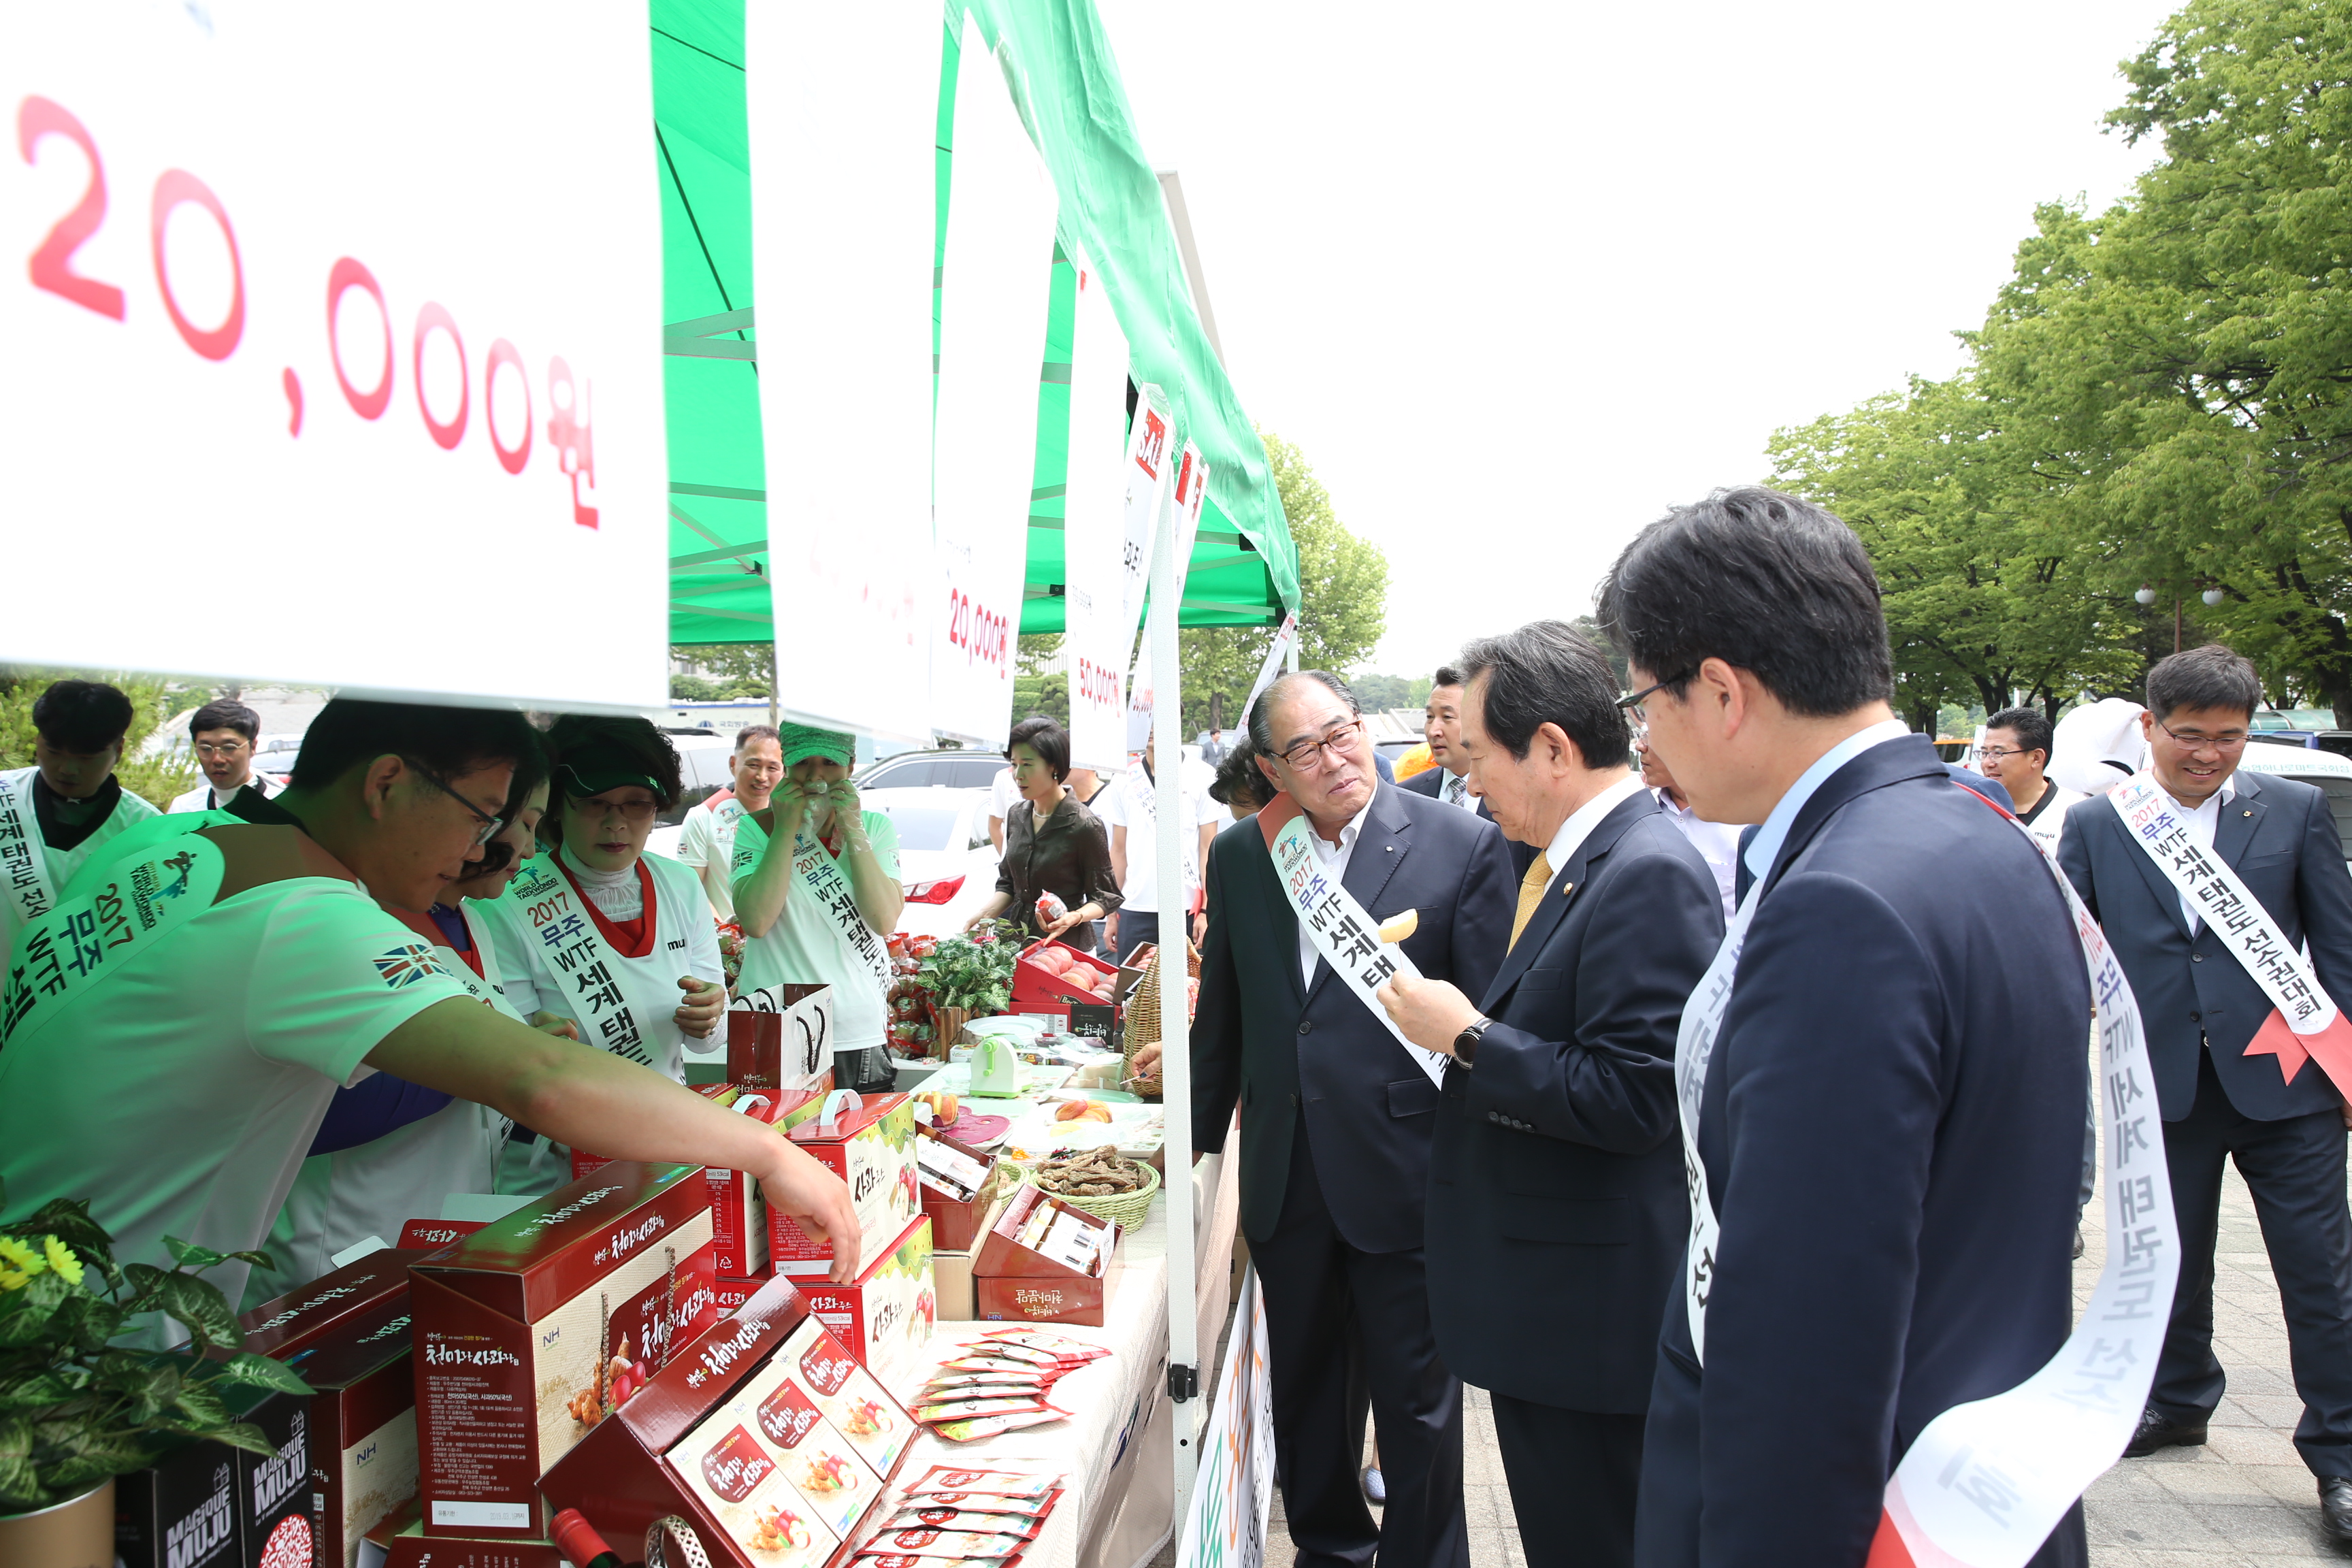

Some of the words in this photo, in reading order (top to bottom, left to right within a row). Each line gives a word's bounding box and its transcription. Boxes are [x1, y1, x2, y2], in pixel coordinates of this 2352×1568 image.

[16, 94, 600, 531] 20,000원
[950, 587, 1009, 680] 20,000원
[2132, 798, 2160, 828] 2017
[2141, 812, 2175, 840] 무주
[2034, 832, 2055, 840] muju
[2153, 827, 2187, 858] WTF
[1, 841, 39, 890] 태권도
[796, 851, 824, 875] 2017
[806, 864, 836, 886] 무주
[1290, 855, 1314, 896] 2017
[514, 883, 537, 896] WORLD
[517, 877, 557, 900] TAEKWONDO
[815, 877, 844, 903] WTF
[1298, 872, 1328, 912] 무주
[95, 883, 133, 949] 2017
[527, 891, 569, 928] 2017
[1308, 892, 1343, 932] WTF
[58, 909, 103, 978] 무주
[541, 913, 585, 948] 무주
[830, 892, 860, 928] 세계
[847, 919, 881, 967] 태권도
[1330, 914, 1379, 968] 세계
[2173, 845, 2216, 885] 세계
[2197, 877, 2259, 936] 태권도
[2244, 928, 2322, 1021] 선수권대회
[26, 927, 67, 996] WTF
[553, 935, 598, 973] WTF
[577, 960, 624, 1014] 세계
[855, 1166, 886, 1203] 사과주스
[412, 1228, 457, 1243] 사과주스
[1015, 1289, 1064, 1304] 천마분말
[543, 1326, 560, 1348] NH
[872, 1301, 904, 1343] 사과주스
[806, 1358, 833, 1386] 천마랑
[764, 1407, 795, 1438] 천마랑
[357, 1442, 377, 1466] NH
[254, 1448, 307, 1517] MUJU
[708, 1456, 744, 1490] 천마랑
[167, 1503, 232, 1568] MUJU
